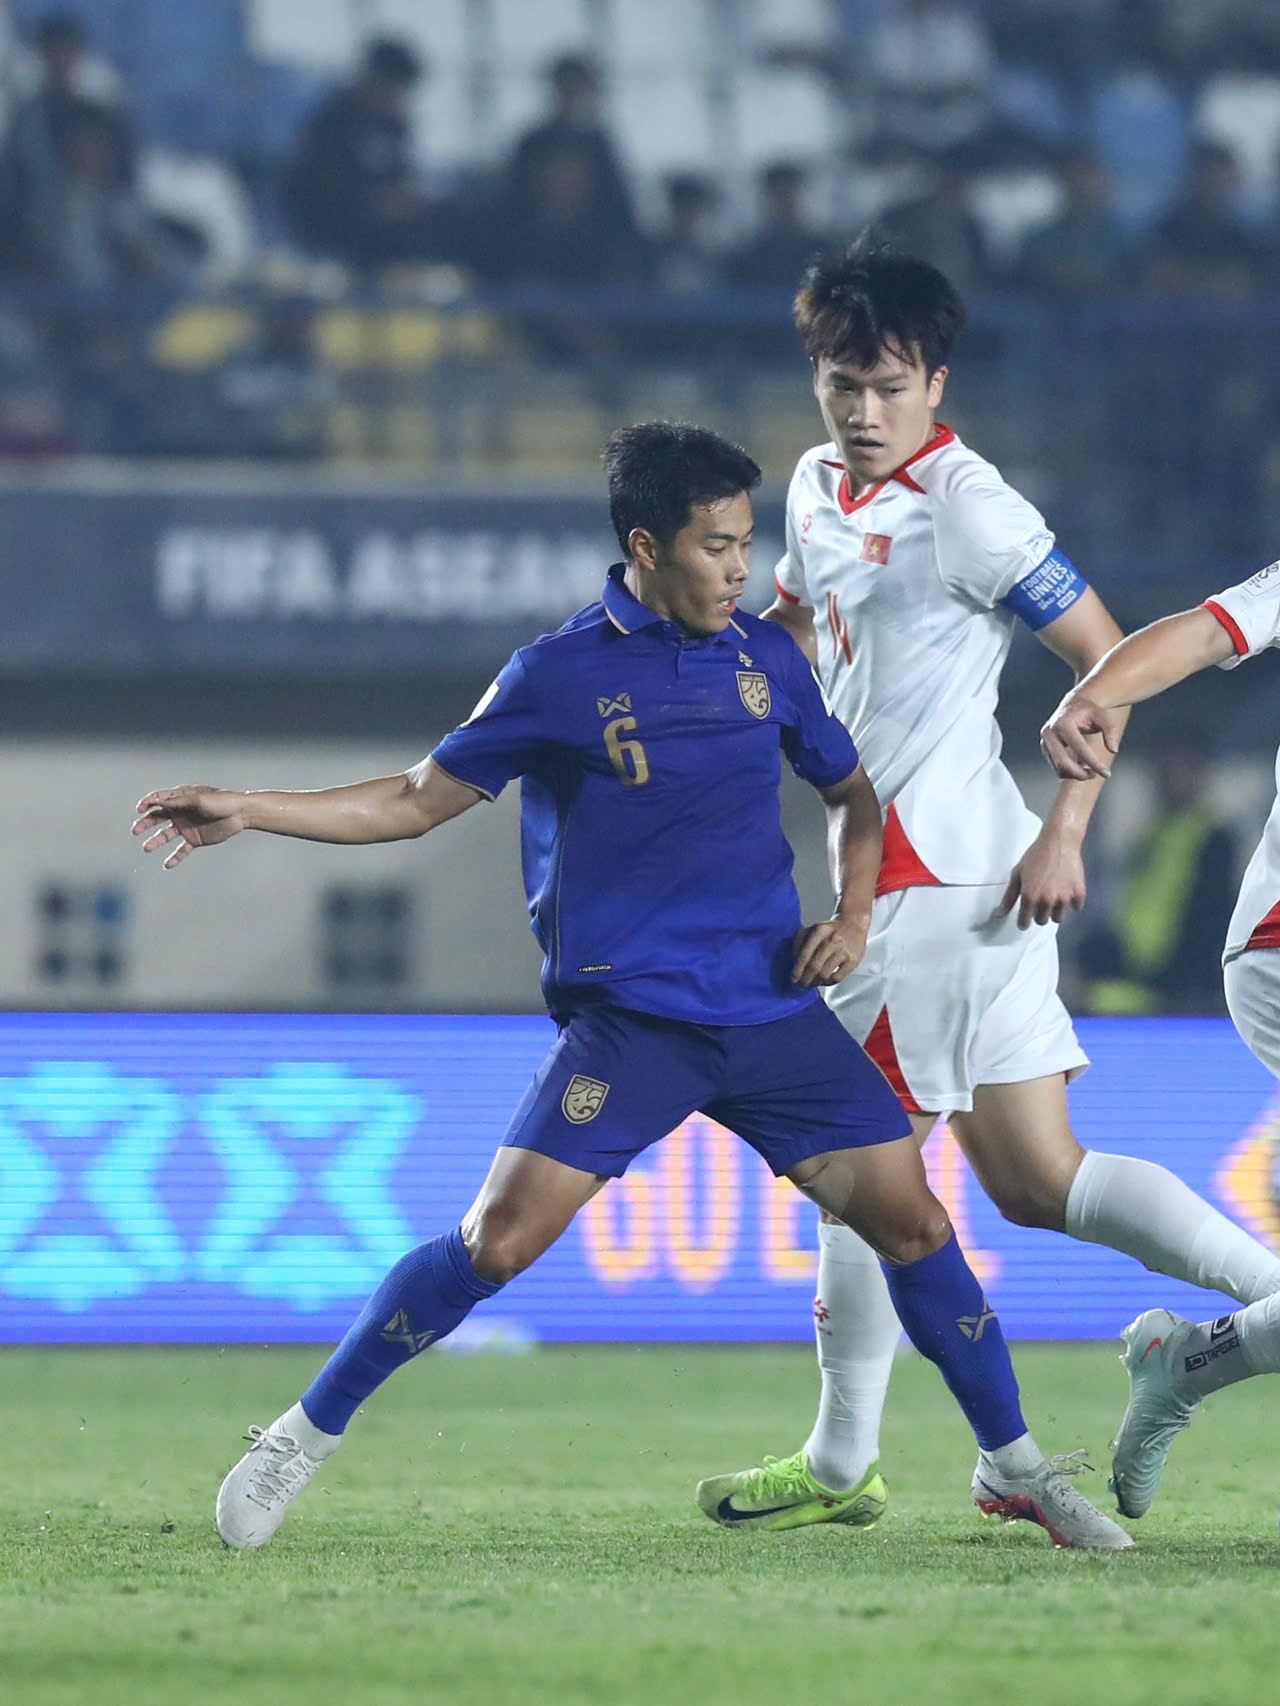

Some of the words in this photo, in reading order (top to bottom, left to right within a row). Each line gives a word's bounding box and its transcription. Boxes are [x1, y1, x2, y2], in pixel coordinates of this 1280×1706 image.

[1021, 557, 1057, 591] FOOTBALL
[1027, 563, 1068, 601] UNITES
[603, 716, 649, 785] 6
